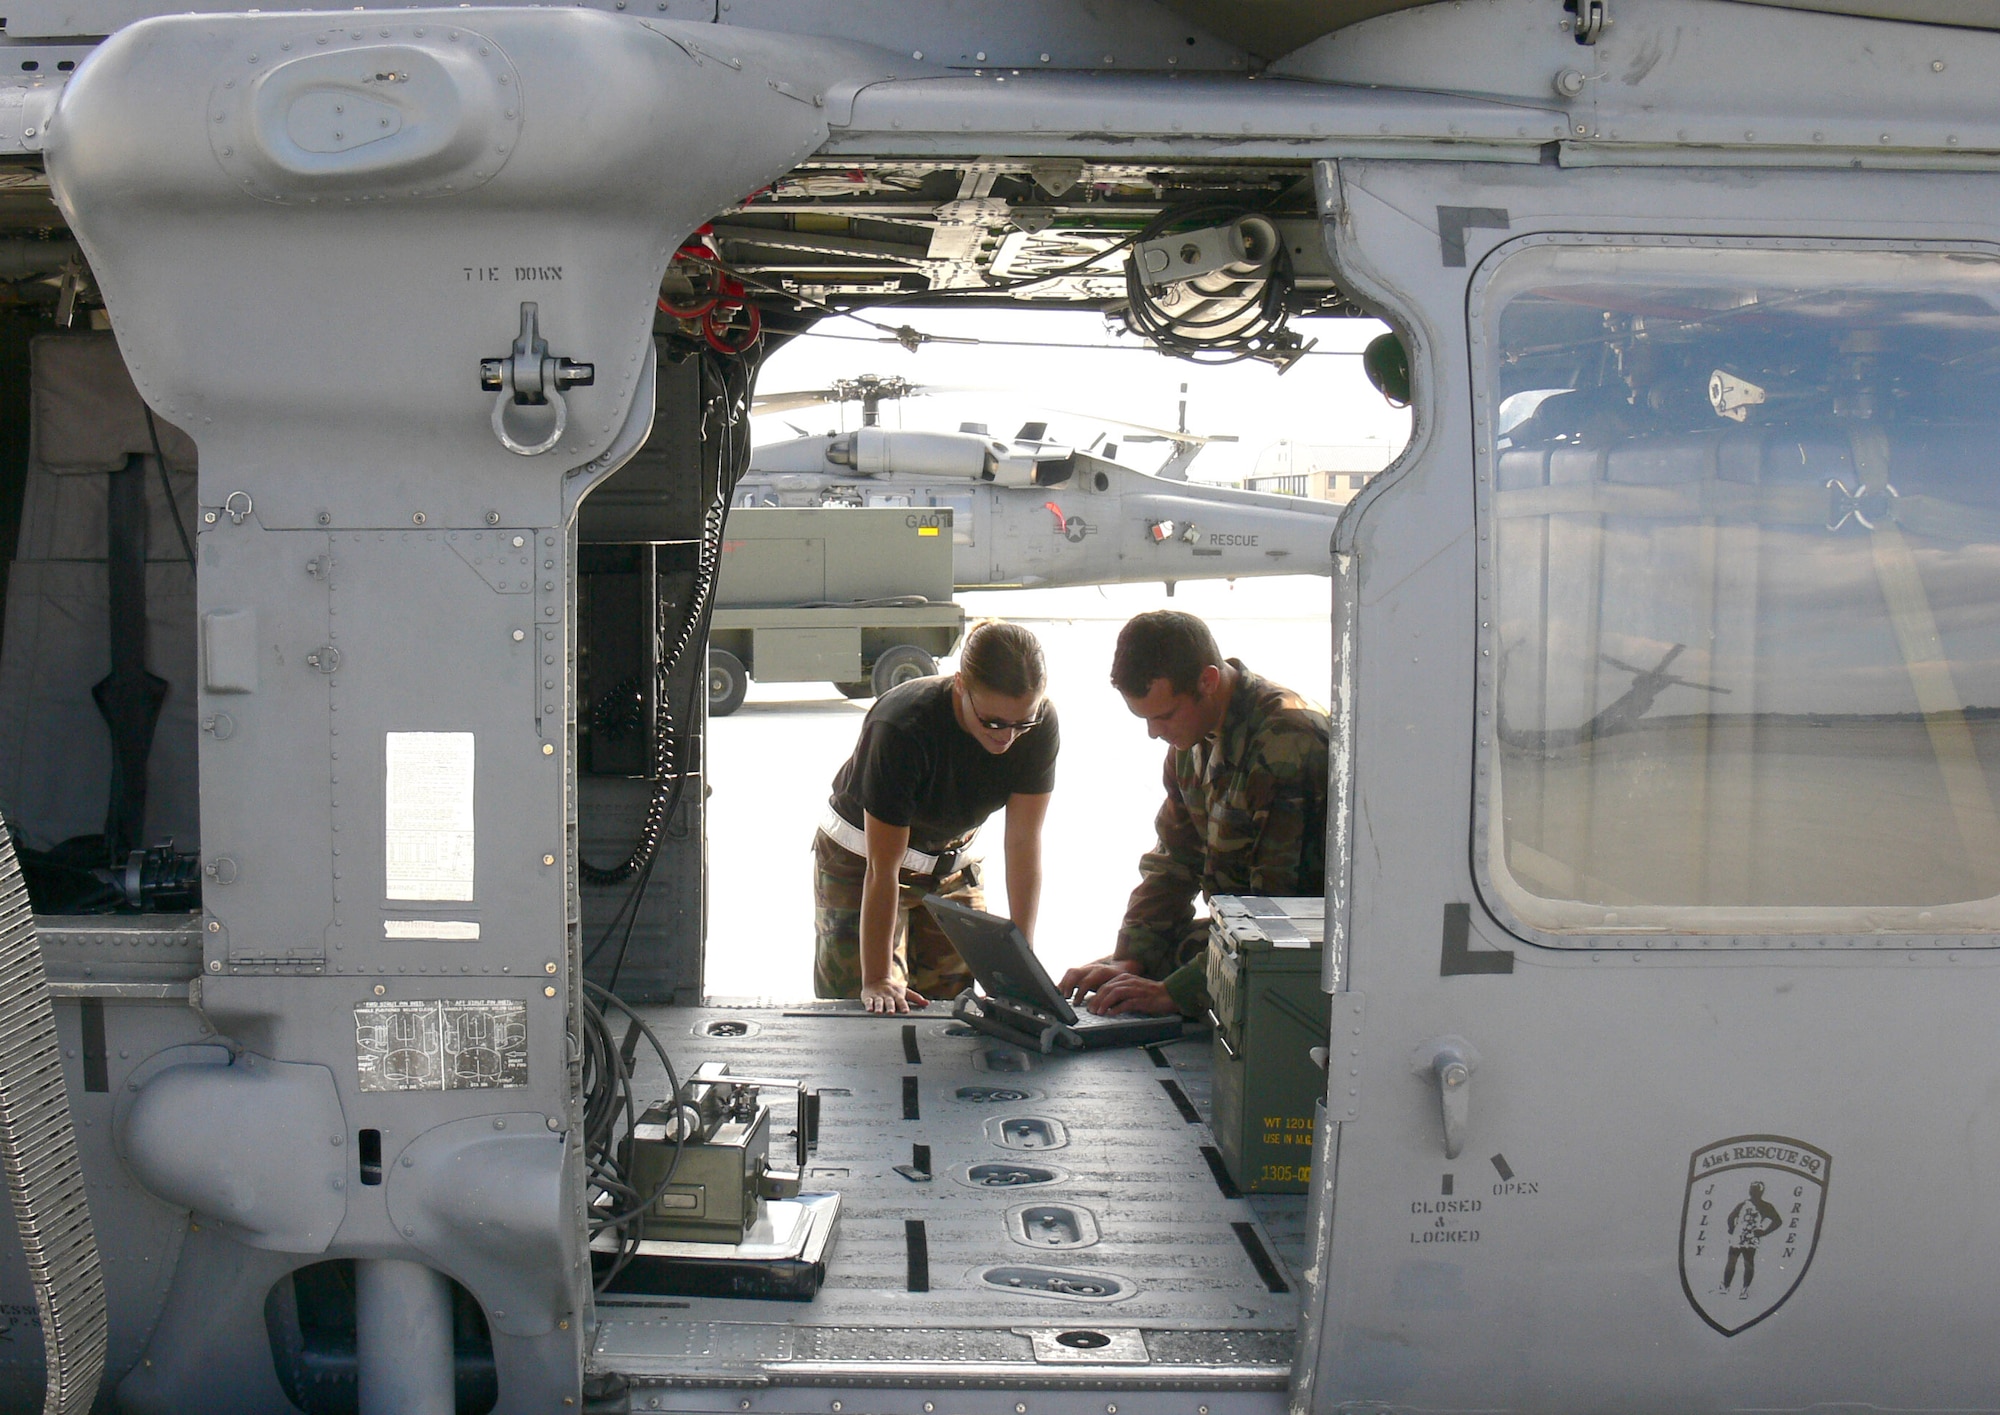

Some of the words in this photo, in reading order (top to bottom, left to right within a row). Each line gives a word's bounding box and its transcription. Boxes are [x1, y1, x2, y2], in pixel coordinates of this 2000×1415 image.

[463, 267, 499, 281] TIE
[515, 266, 562, 281] DOWN
[1210, 533, 1259, 547] RESCUE
[1263, 1117, 1281, 1128] WT
[1286, 1118, 1305, 1129] 120
[1263, 1133, 1280, 1144] USE
[1283, 1134, 1293, 1144] IN
[1701, 1151, 1730, 1169] 41st
[1732, 1146, 1798, 1165] RESCUE
[1799, 1154, 1821, 1174] SQ
[1492, 1181, 1539, 1196] OPEN
[1411, 1200, 1482, 1214] CLOSED
[1696, 1184, 1715, 1257] JOLLY
[1782, 1186, 1803, 1259] GREEN
[1410, 1230, 1480, 1244] LOCKED
